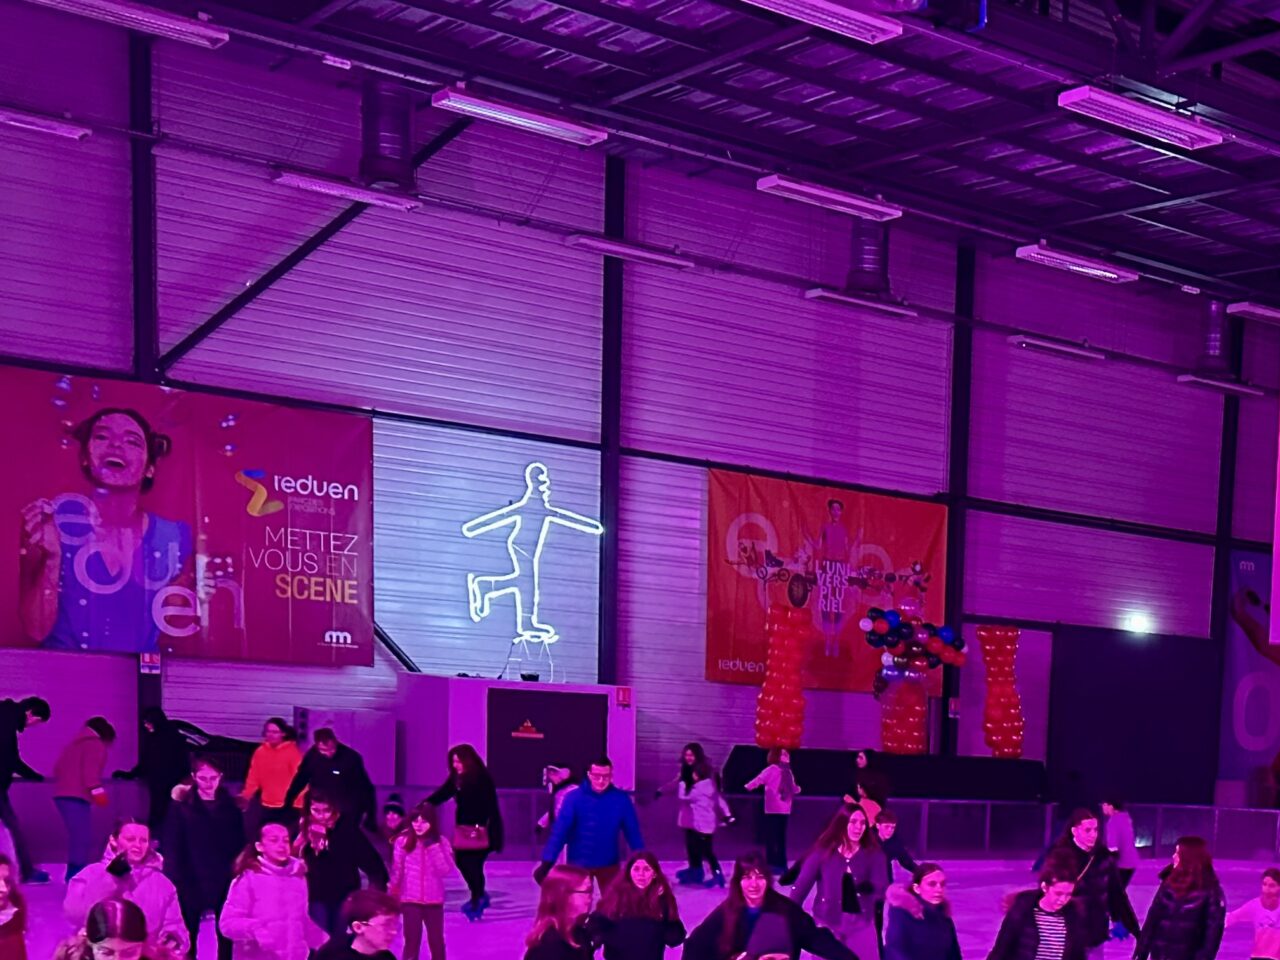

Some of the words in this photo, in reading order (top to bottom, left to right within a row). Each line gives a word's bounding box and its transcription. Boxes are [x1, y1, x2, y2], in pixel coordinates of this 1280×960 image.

[264, 526, 359, 556] METTEZ
[249, 546, 319, 574] VOUS
[326, 554, 358, 577] EN
[275, 573, 359, 604] SCENE
[816, 573, 849, 587] VERS
[820, 585, 846, 601] PLU
[819, 599, 847, 613] RIEL
